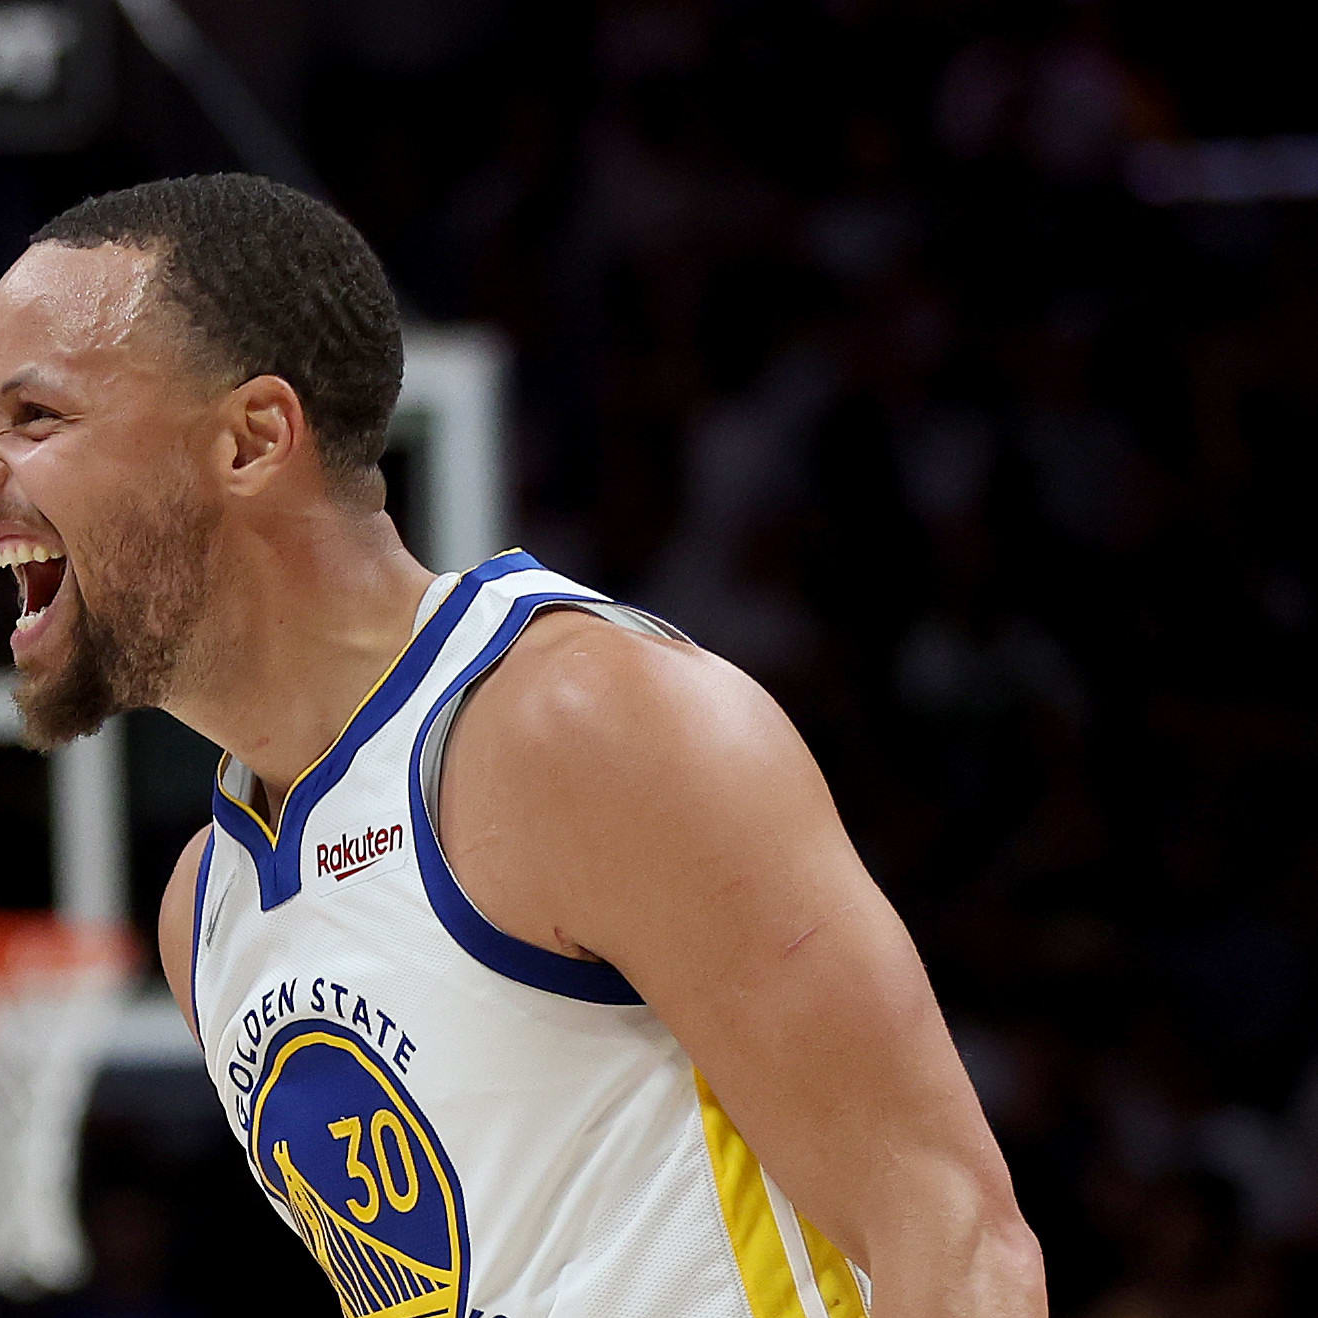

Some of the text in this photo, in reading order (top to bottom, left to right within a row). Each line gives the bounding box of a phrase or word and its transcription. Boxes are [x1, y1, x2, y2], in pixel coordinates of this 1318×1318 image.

[316, 823, 403, 877] Rakuten
[228, 976, 417, 1132] GOLDEN STATE
[327, 1108, 419, 1223] 30
